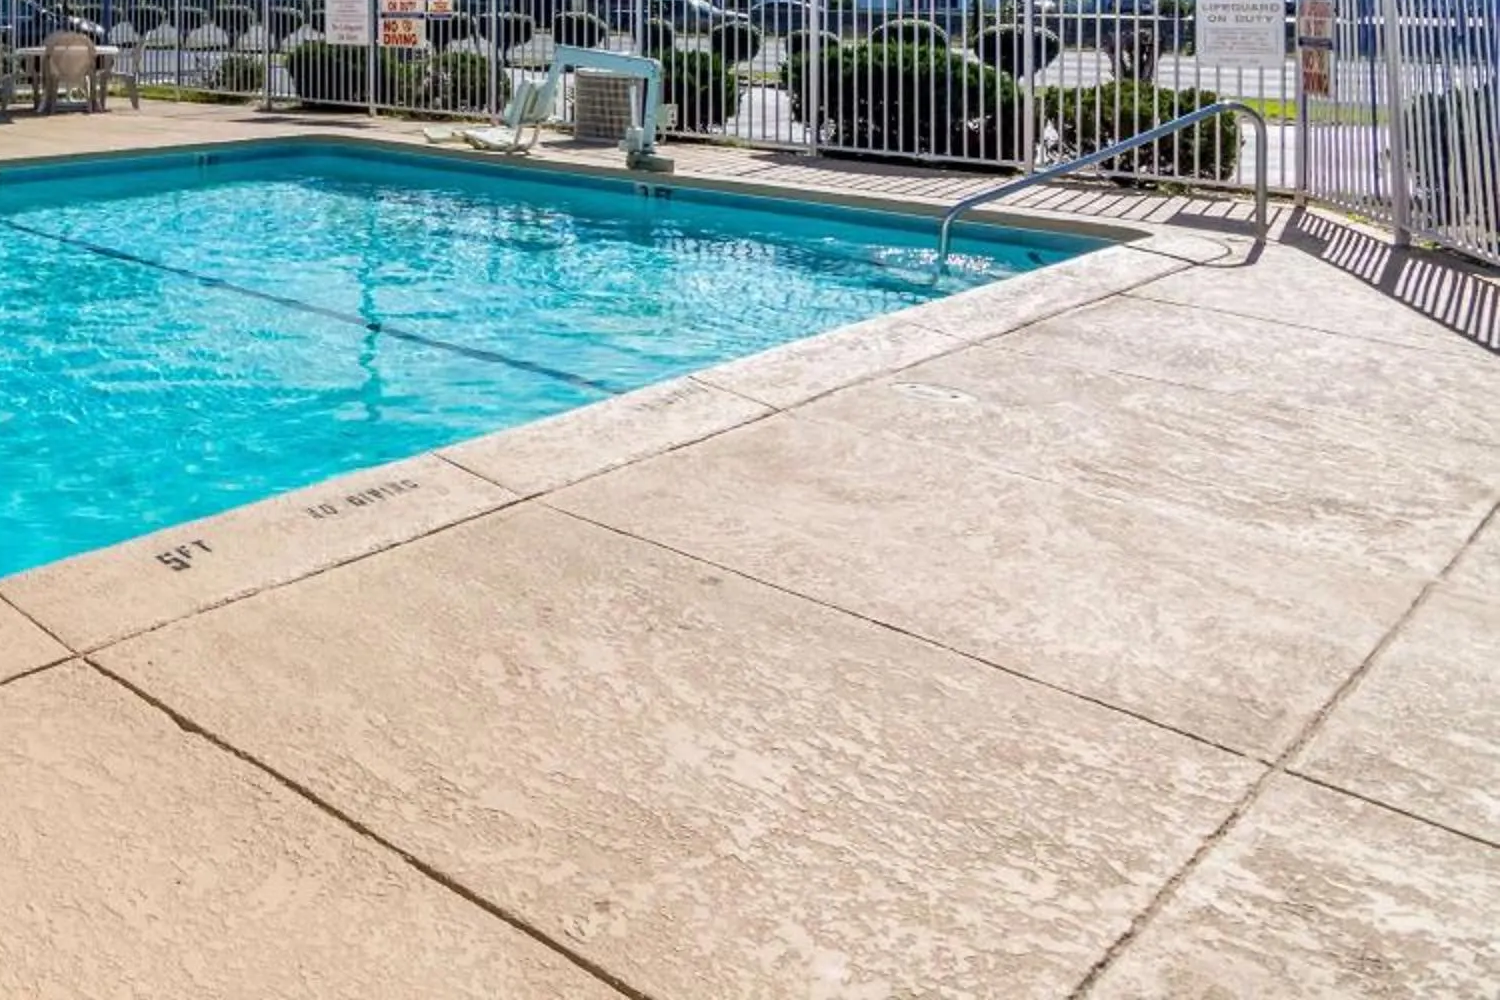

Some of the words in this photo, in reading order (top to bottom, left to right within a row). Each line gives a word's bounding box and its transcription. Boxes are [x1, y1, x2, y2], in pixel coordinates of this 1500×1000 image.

[1202, 3, 1280, 12] LIFEGUARD
[1207, 14, 1227, 22] ON
[1235, 14, 1273, 22] DUTY
[383, 21, 398, 32] NO
[383, 33, 417, 45] DIVING
[154, 539, 213, 572] 5FT
